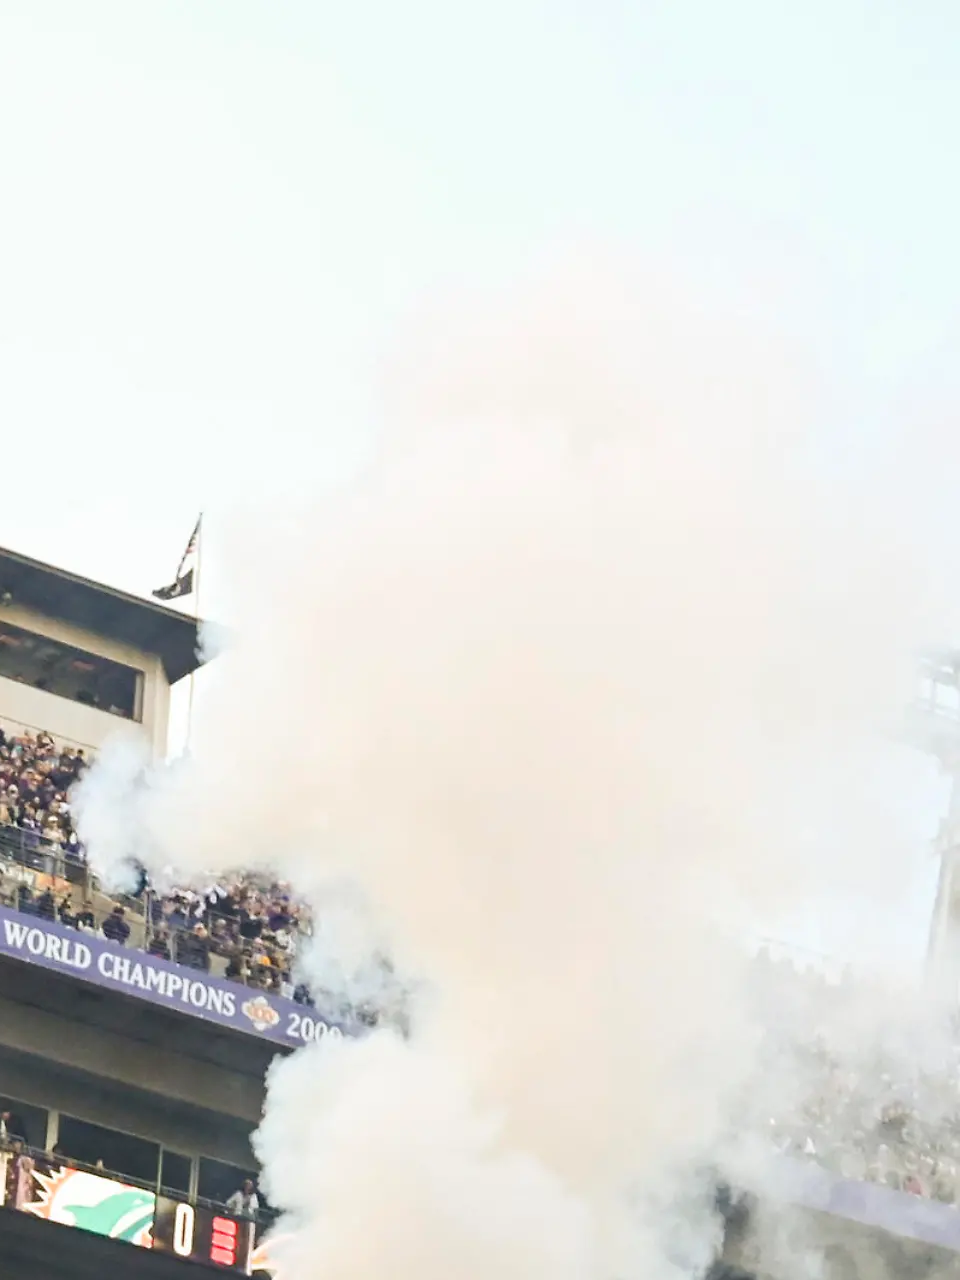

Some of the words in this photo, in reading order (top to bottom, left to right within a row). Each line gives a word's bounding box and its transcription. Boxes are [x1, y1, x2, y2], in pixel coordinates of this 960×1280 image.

[3, 919, 92, 970] WORLD
[97, 951, 237, 1018] CHAMPIONS
[173, 1202, 195, 1257] 0
